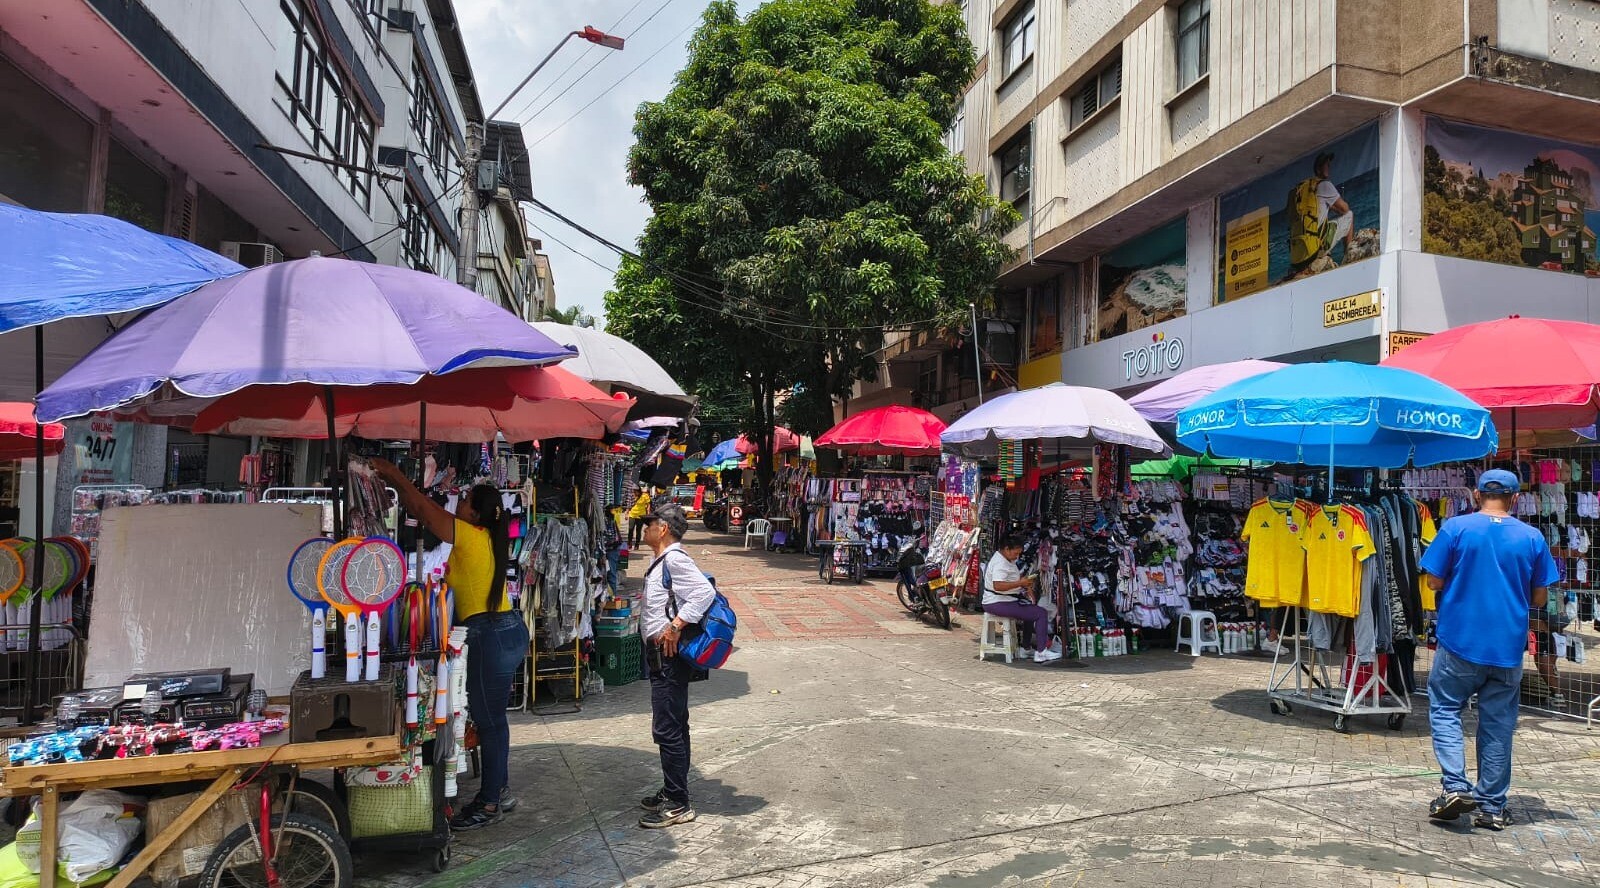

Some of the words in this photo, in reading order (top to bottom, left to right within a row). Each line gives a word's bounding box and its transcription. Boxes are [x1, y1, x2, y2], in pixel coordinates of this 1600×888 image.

[1326, 301, 1348, 313] CALLE
[1349, 298, 1357, 308] 14
[1326, 313, 1335, 323] LA
[1337, 305, 1377, 321] SOMBREREA
[1392, 335, 1422, 346] CARRE
[1122, 336, 1185, 381] TOTTO
[1187, 409, 1225, 427] HONOR
[1396, 409, 1462, 429] HONOR
[85, 435, 117, 461] 24/7
